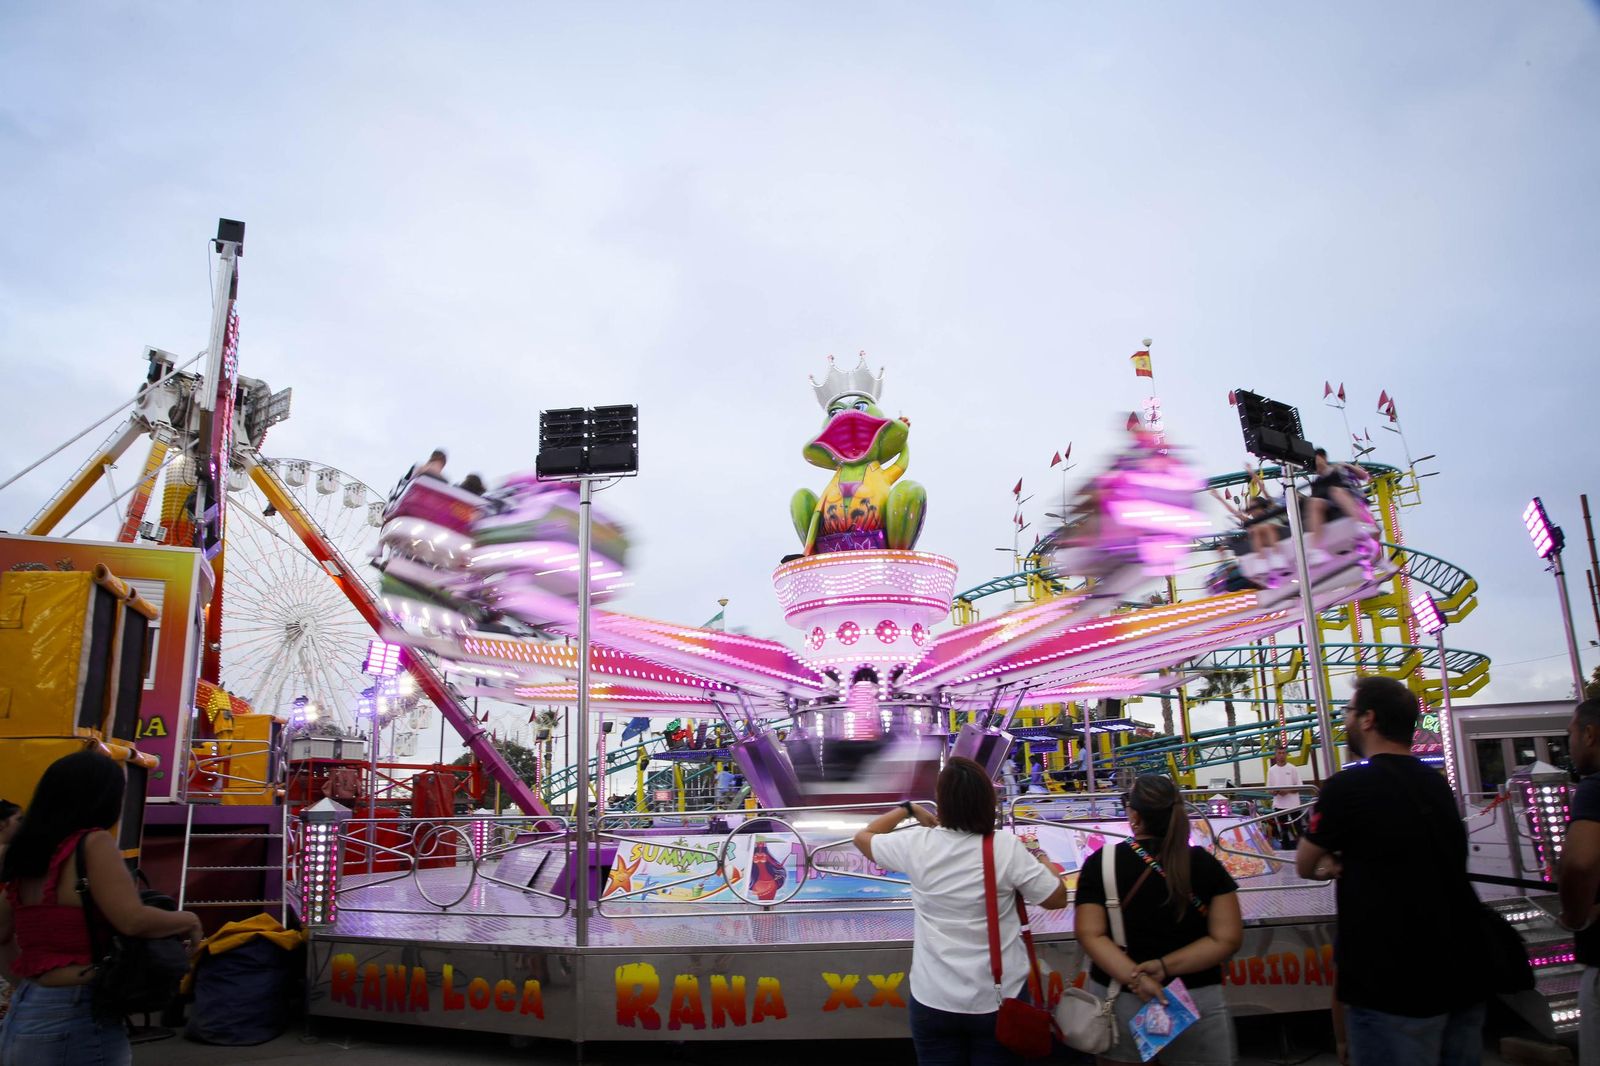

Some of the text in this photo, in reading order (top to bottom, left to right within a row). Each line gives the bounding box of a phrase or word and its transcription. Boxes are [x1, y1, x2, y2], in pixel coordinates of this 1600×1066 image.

[630, 841, 737, 867] SUMMER
[791, 842, 889, 884] TROPIC
[331, 952, 545, 1020] RANA LOCA
[1221, 944, 1334, 987] URIDA
[614, 961, 788, 1031] RANA
